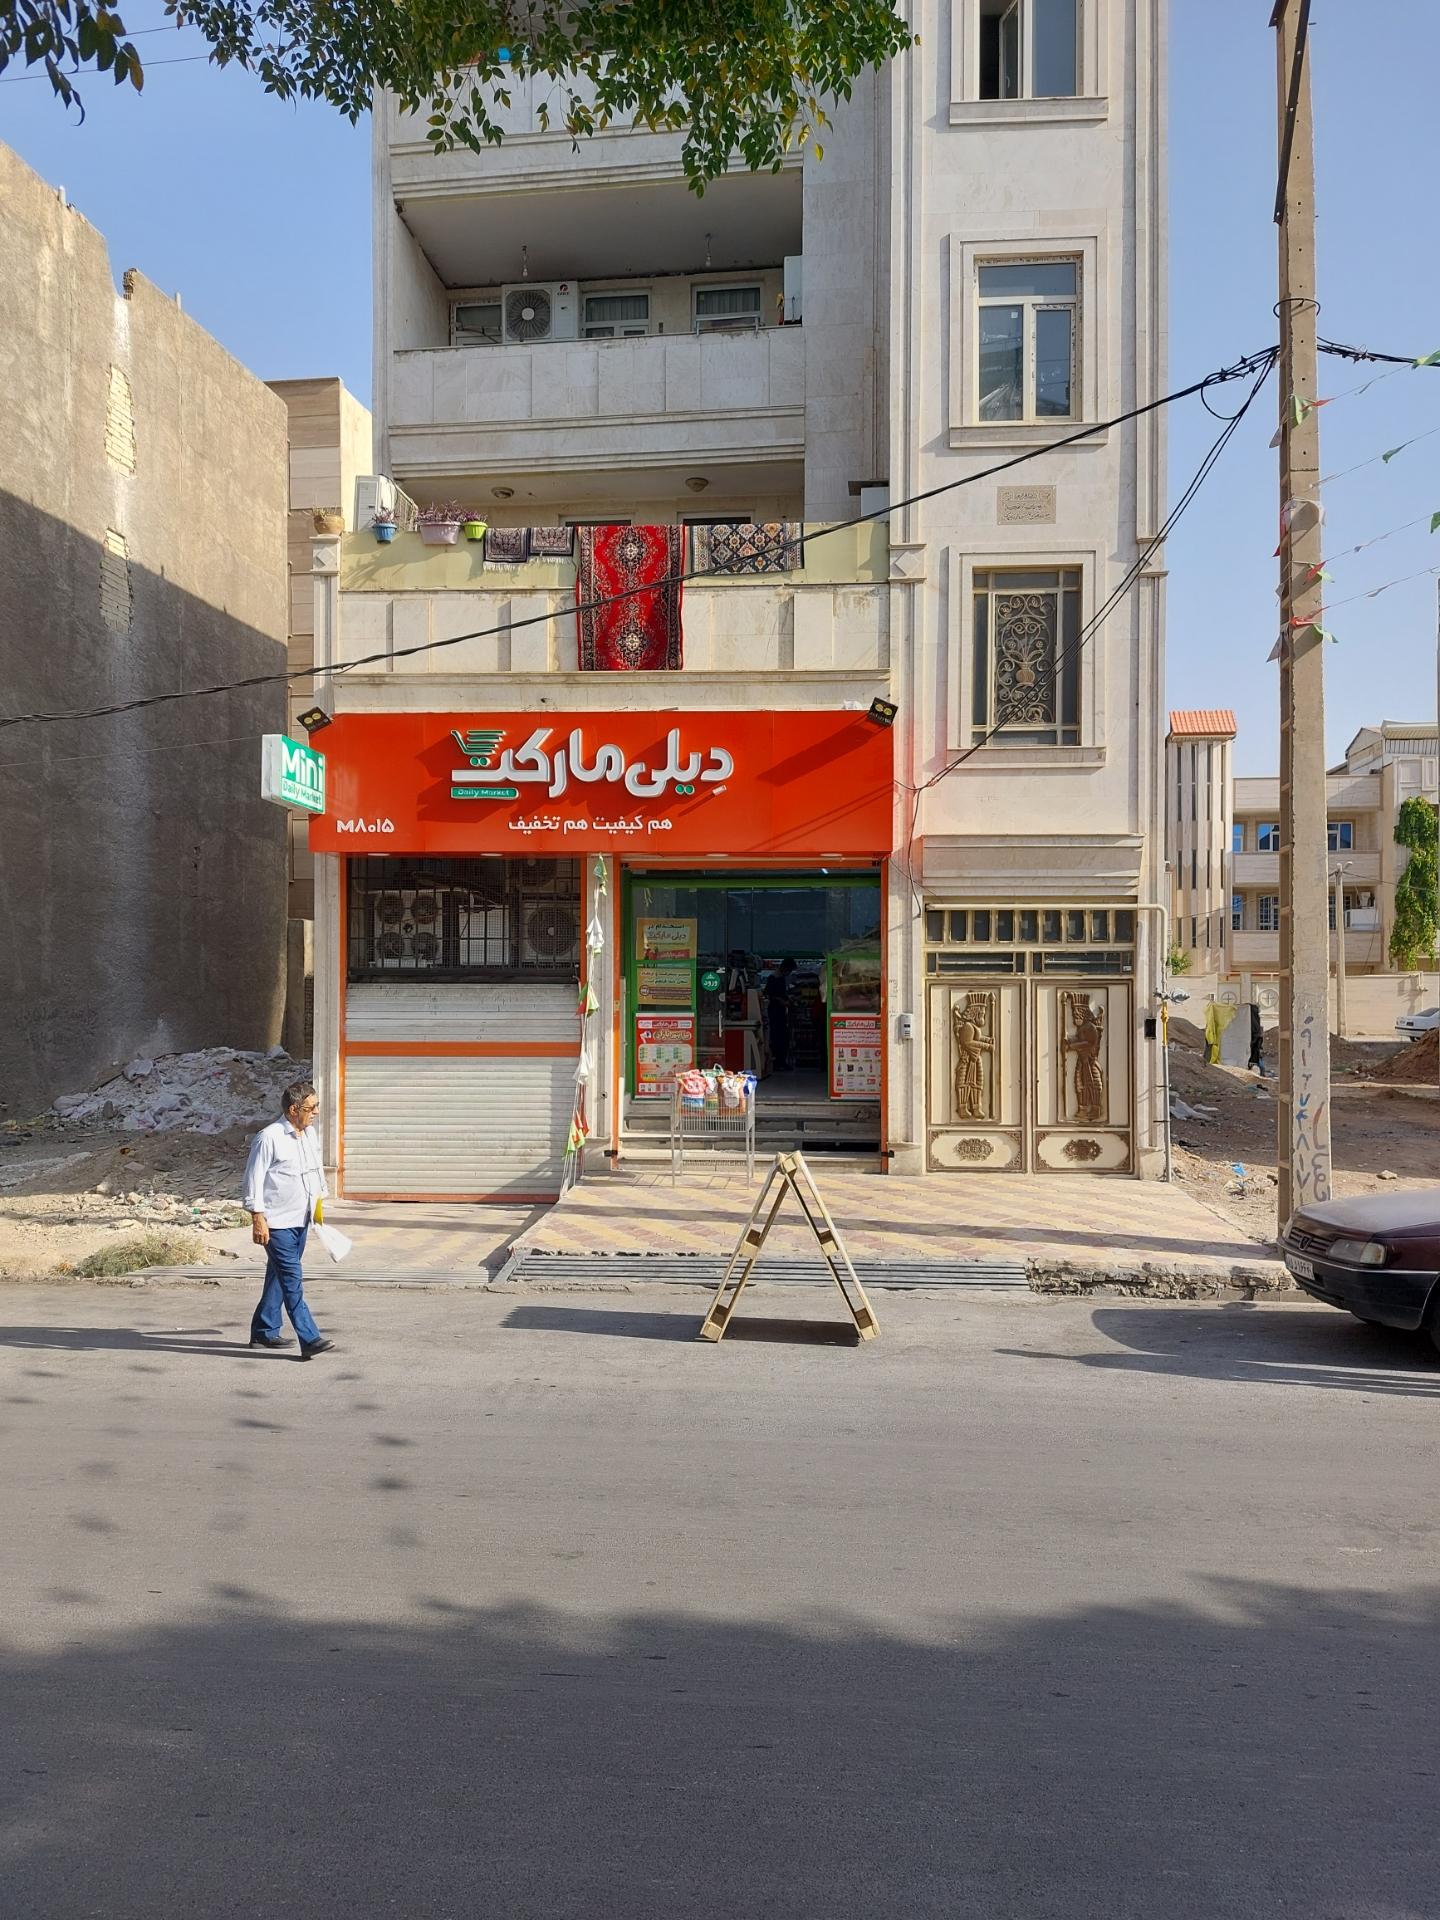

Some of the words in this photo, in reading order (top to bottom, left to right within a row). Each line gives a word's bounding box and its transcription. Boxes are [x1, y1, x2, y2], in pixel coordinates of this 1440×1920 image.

[281, 741, 324, 792] Mini
[451, 728, 625, 798] مارکت
[624, 728, 734, 798] دیلی
[283, 781, 300, 799] Daily
[301, 789, 322, 805] Market
[458, 788, 479, 798] Daily
[481, 789, 510, 797] Market
[508, 815, 561, 835] تخفیف
[563, 818, 589, 835] هم
[592, 815, 643, 835] کیفیت
[647, 817, 673, 835] هم
